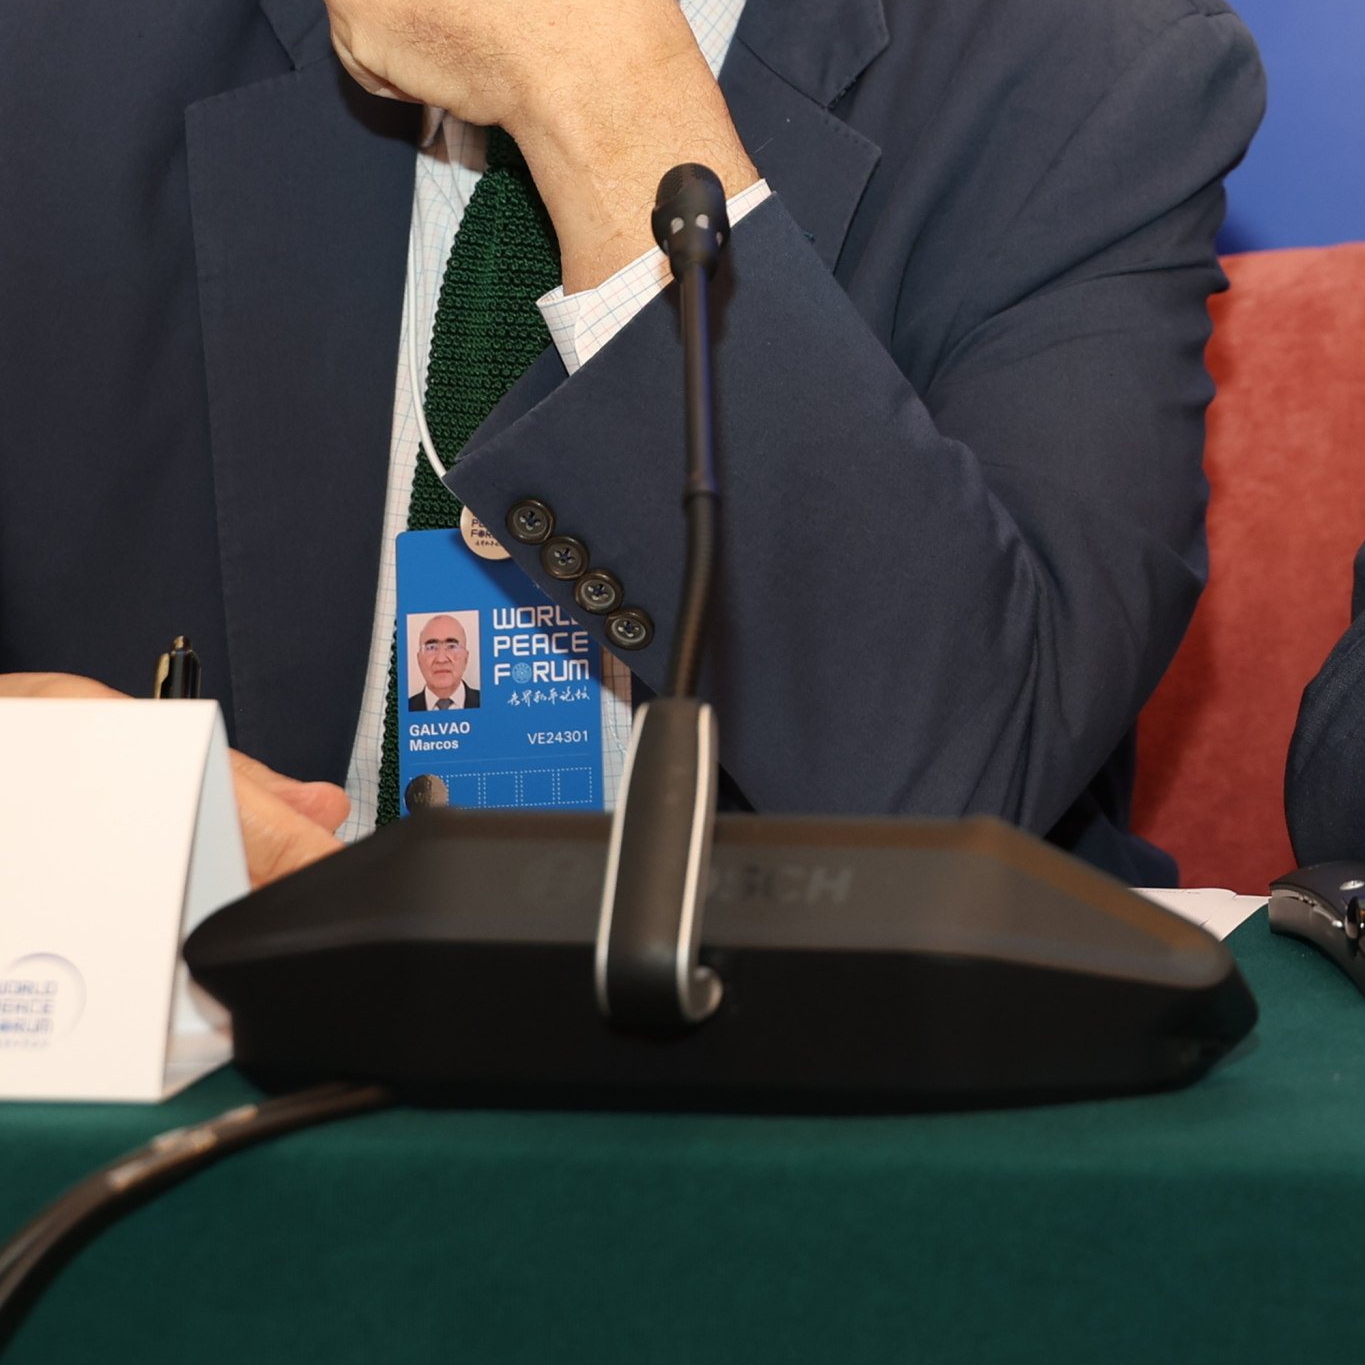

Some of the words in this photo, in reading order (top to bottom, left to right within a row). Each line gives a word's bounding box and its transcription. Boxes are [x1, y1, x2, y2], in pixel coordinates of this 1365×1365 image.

[493, 605, 579, 629] WORL
[494, 631, 588, 657] PEACE
[409, 721, 470, 736] GALVAO
[527, 730, 588, 745] VE24301
[409, 739, 459, 752] Marcos
